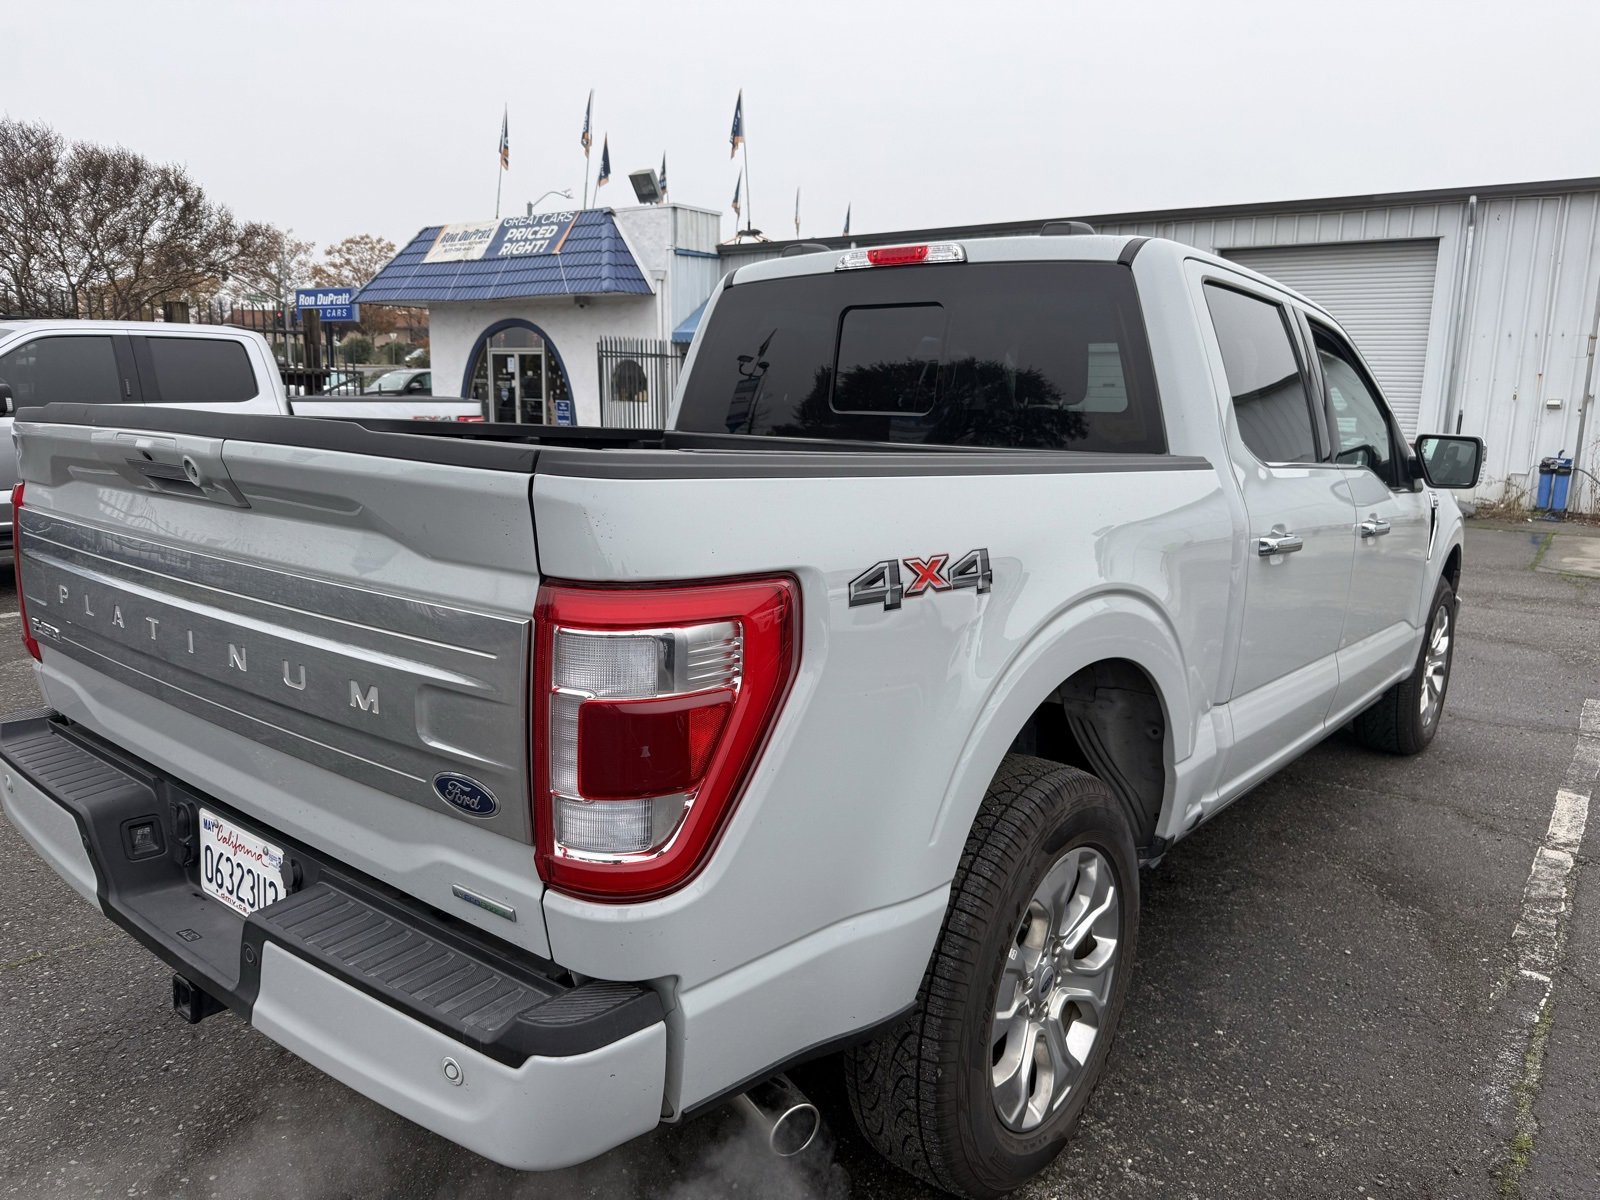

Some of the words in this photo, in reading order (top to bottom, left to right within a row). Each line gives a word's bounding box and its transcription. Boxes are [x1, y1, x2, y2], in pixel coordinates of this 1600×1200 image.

[504, 215, 541, 227] GREAT
[541, 210, 575, 224] CARS
[440, 232, 459, 244] Ron
[459, 227, 494, 241] DuPratt
[505, 226, 559, 241] PRICED
[498, 239, 550, 256] RIGHT!
[298, 293, 315, 306] Ron
[317, 292, 350, 306] DuPratt
[326, 308, 347, 317] CARS
[58, 584, 380, 715] PLATINUM
[445, 780, 481, 811] Ford
[203, 818, 216, 832] MAY
[216, 824, 268, 867] California
